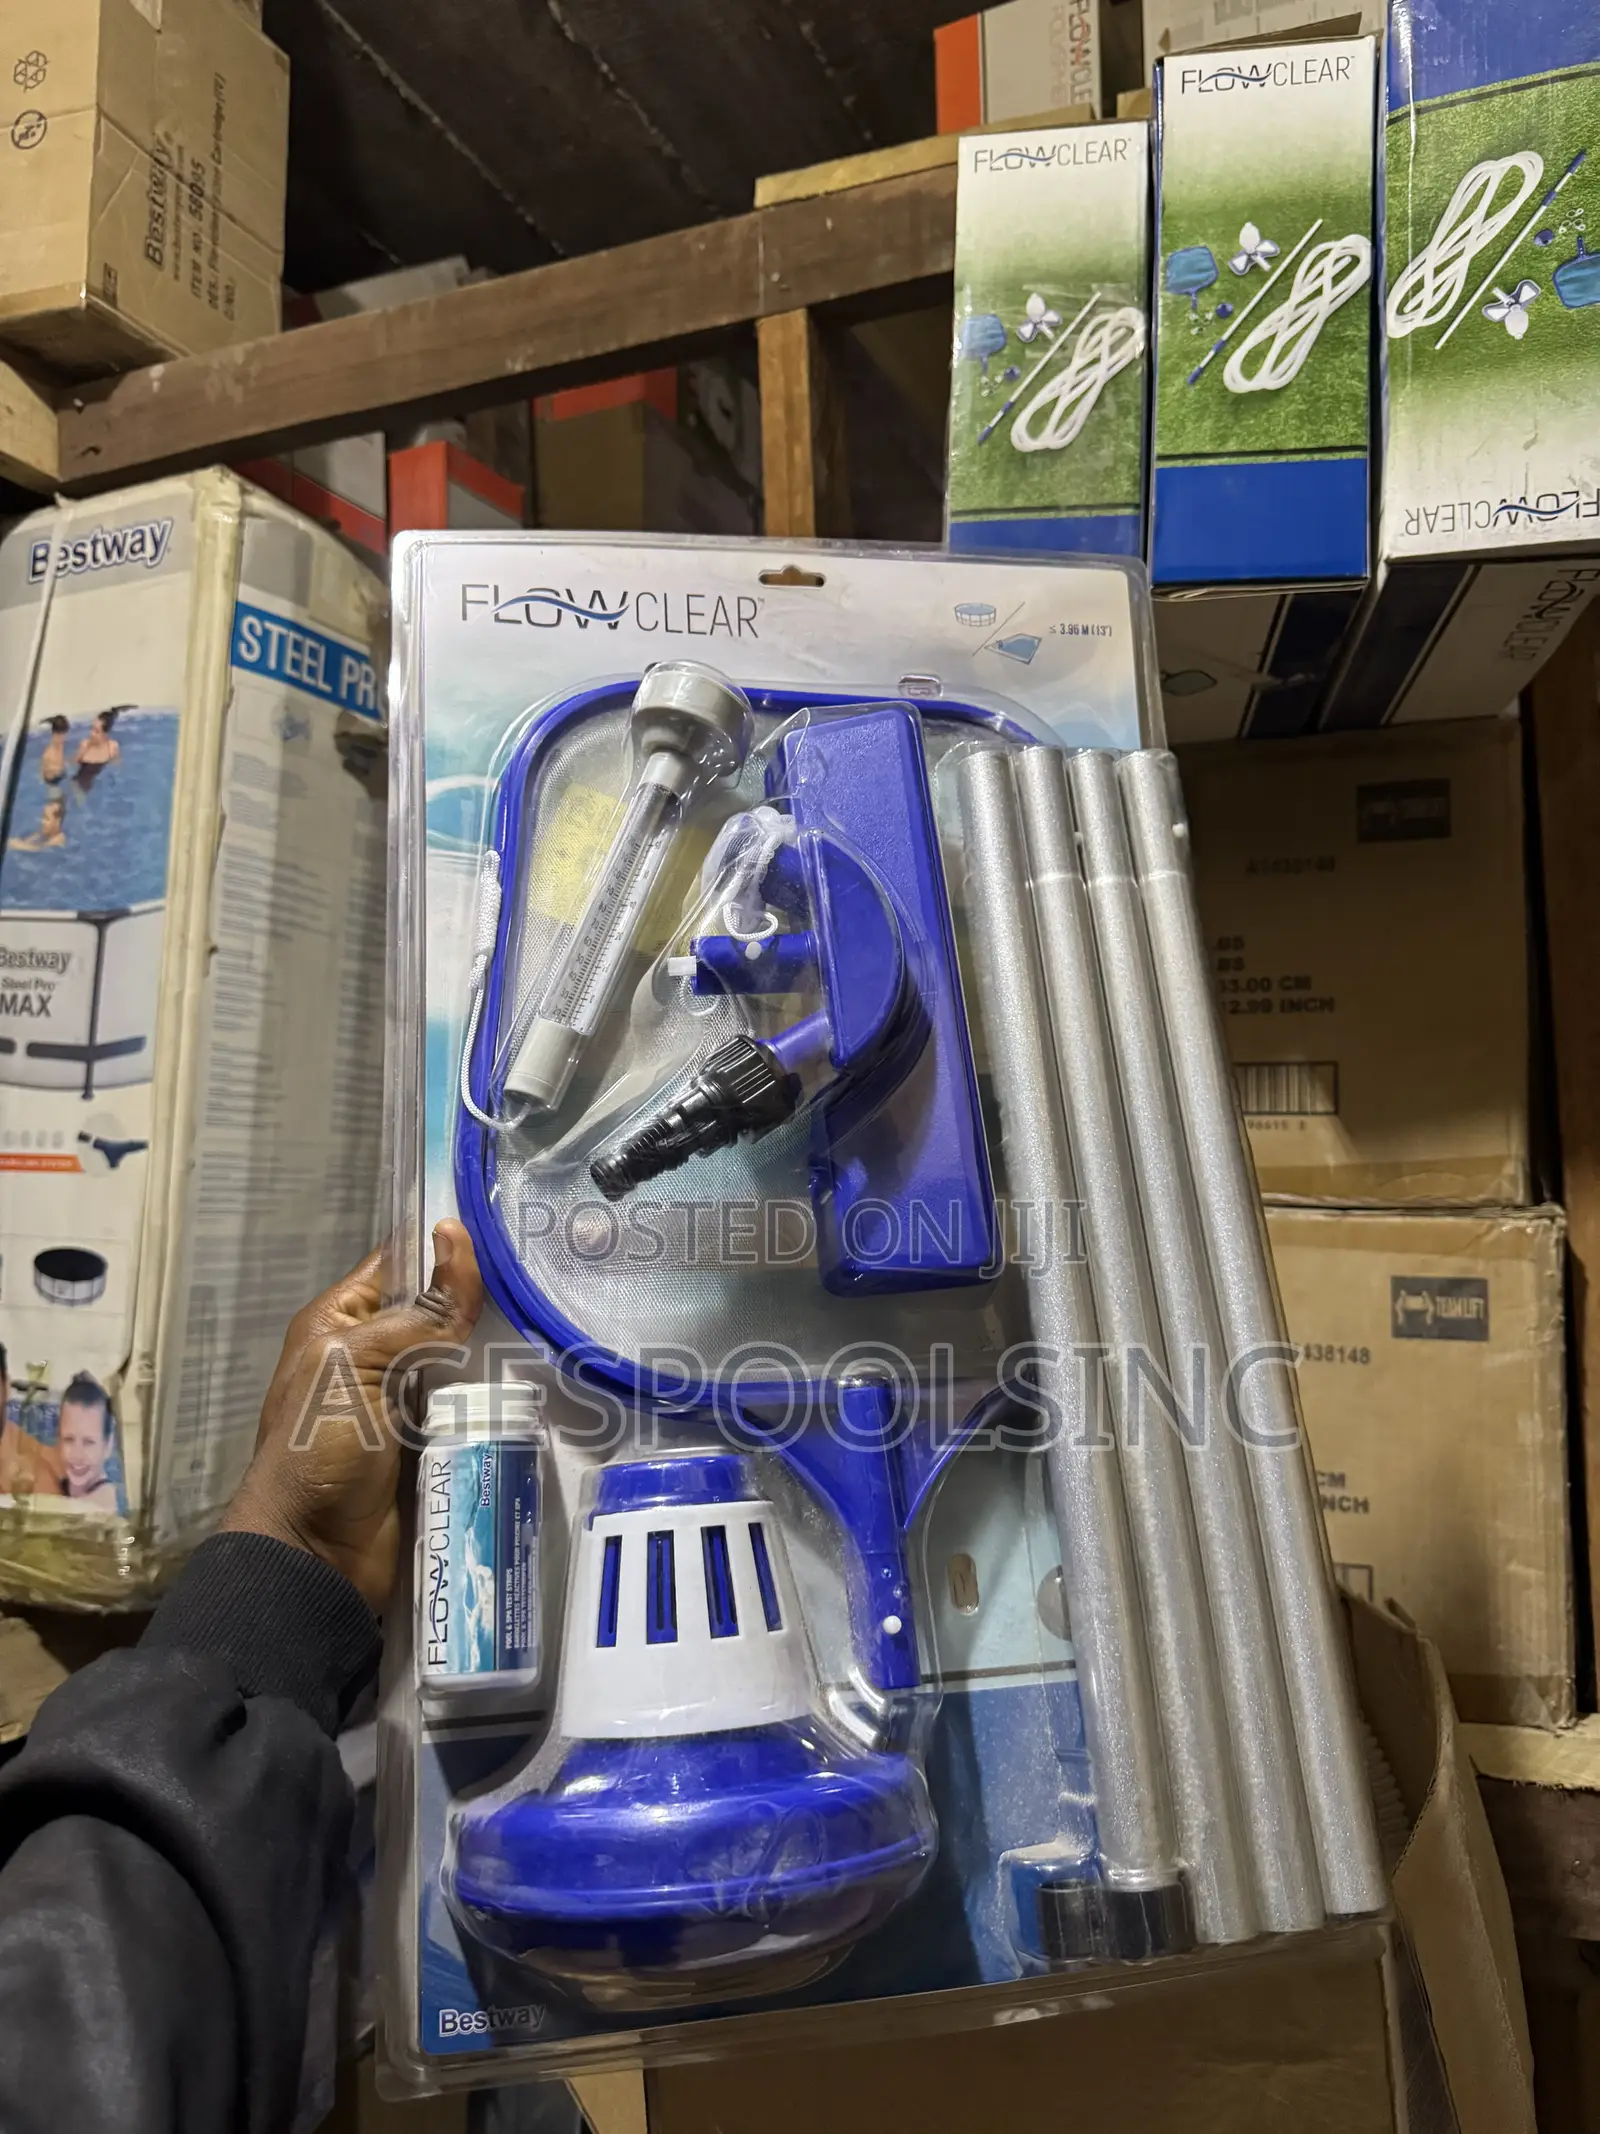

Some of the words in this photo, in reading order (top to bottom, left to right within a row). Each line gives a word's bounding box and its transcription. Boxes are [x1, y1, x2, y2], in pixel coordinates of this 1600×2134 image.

[1181, 56, 1351, 95] FLOWCLEAR
[974, 138, 1128, 173] FLOWCLEAR
[1404, 488, 1600, 536] FLOWCLEAR
[29, 518, 173, 584] Bestway
[461, 583, 759, 638] FLOWCLEAR
[238, 614, 333, 693] STEEL
[1278, 975, 1312, 991] CM
[0, 993, 52, 1018] MAX
[1279, 995, 1336, 1013] INCH
[480, 1452, 493, 1508] Bestway
[1319, 1494, 1370, 1514] NCH
[428, 1459, 451, 1665] FLOWCLEAR
[439, 2004, 546, 2037] Bestway
